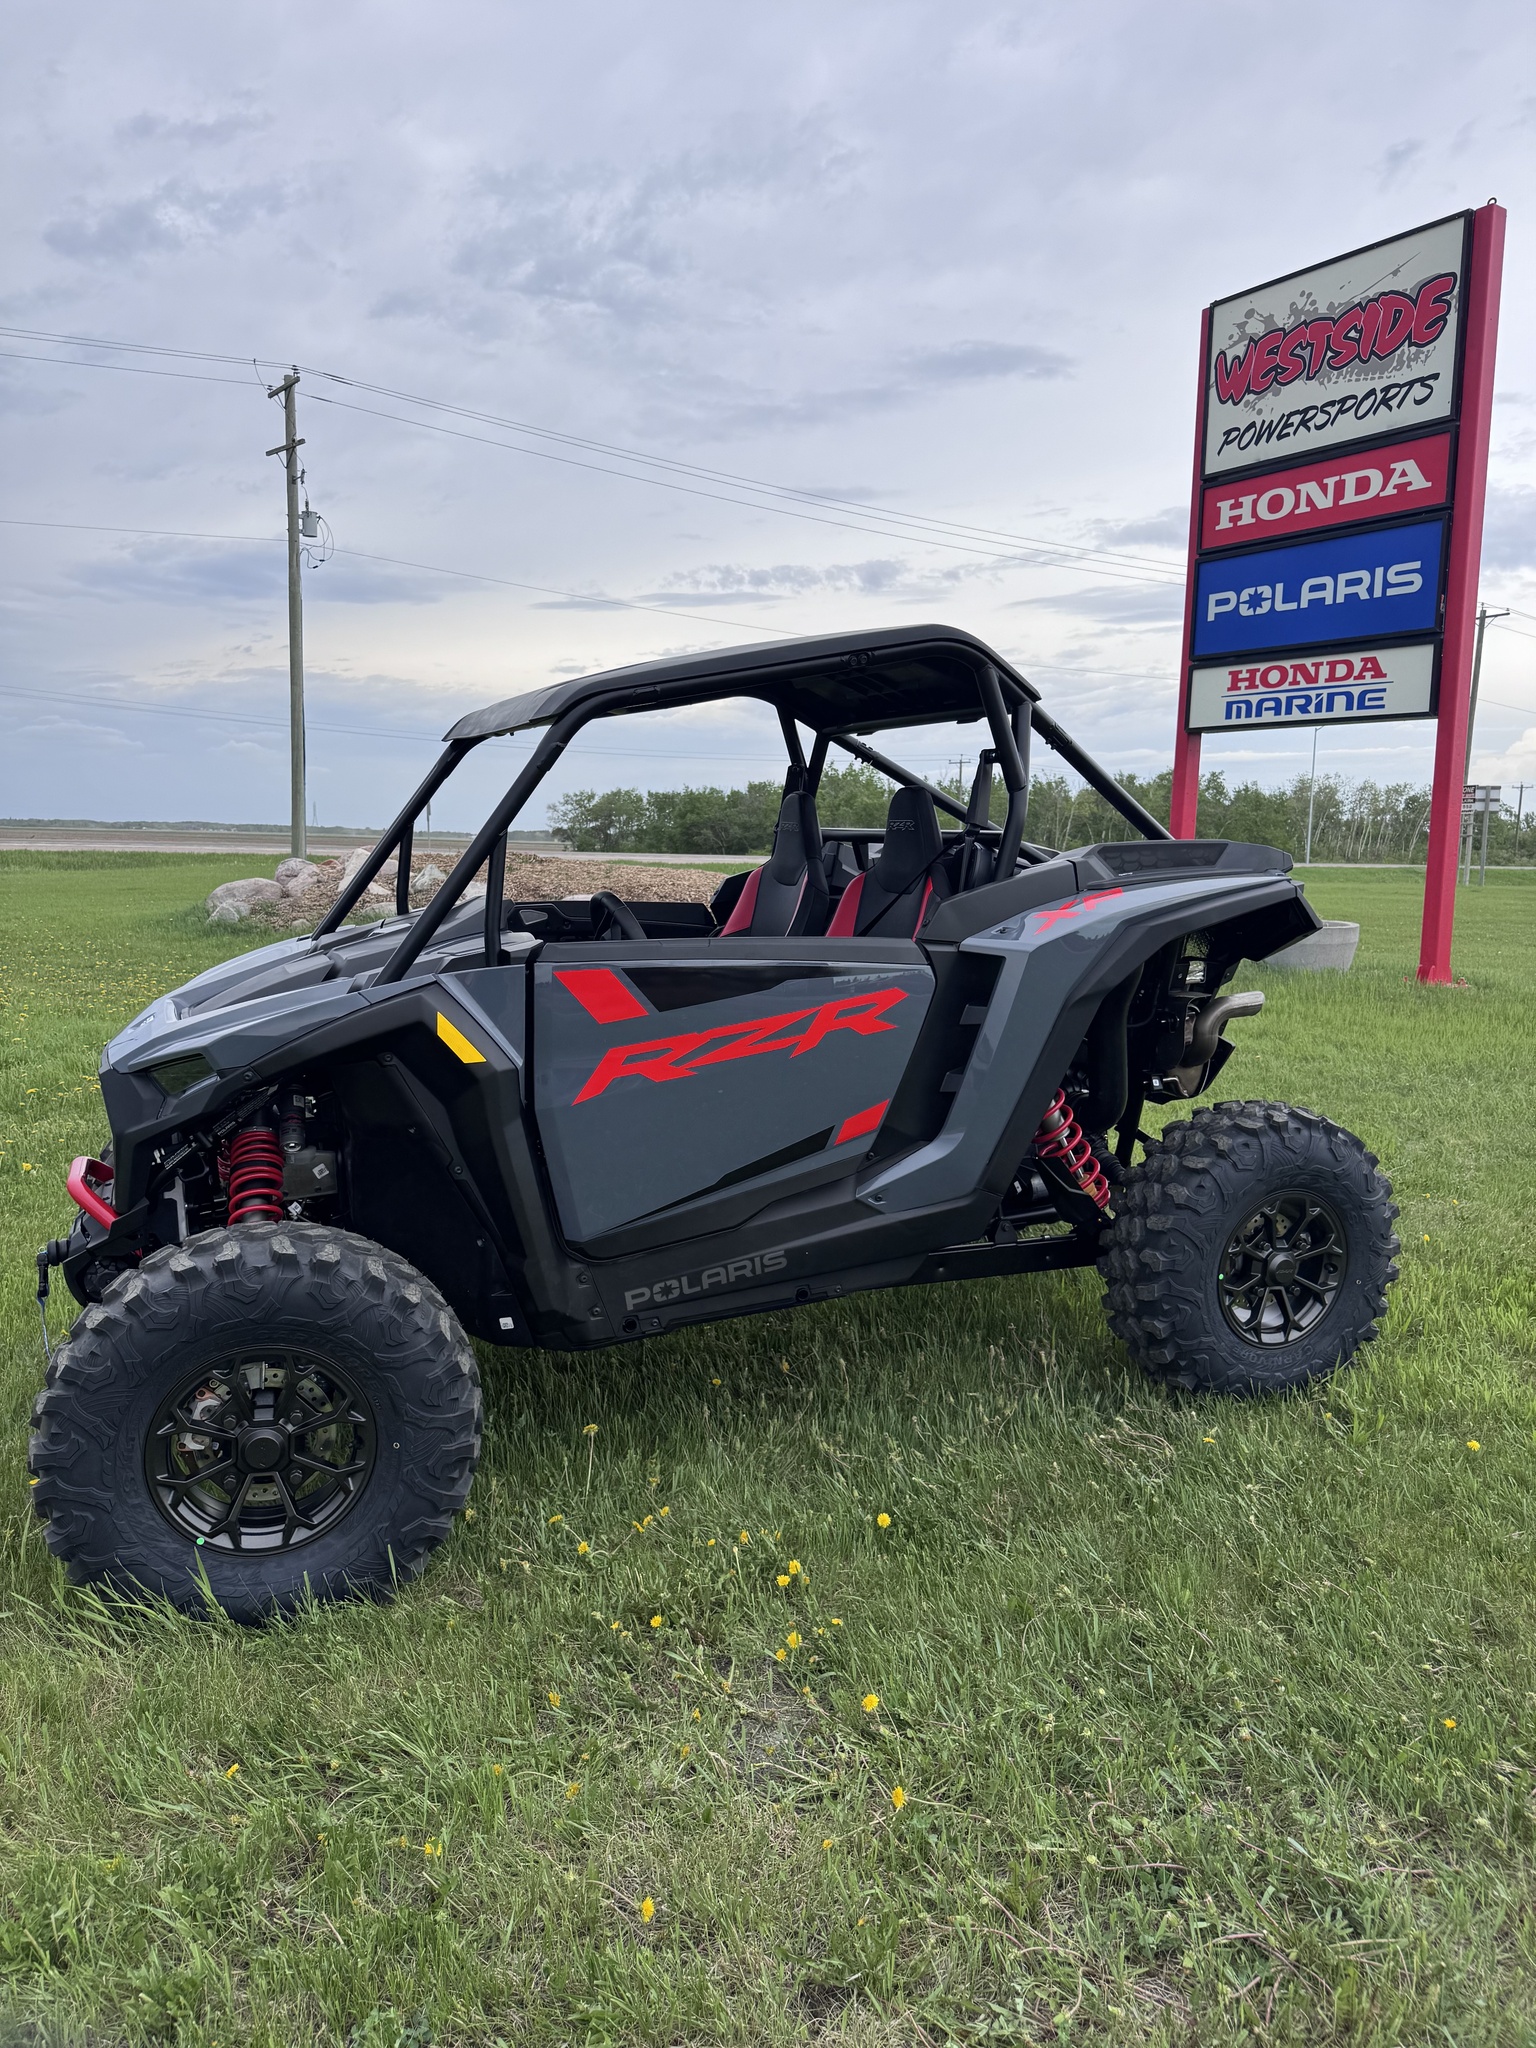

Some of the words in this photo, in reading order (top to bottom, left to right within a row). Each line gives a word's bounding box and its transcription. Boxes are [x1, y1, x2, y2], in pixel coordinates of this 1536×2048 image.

[1215, 272, 1457, 405] WESTSIDE
[1218, 373, 1440, 456] POWERSPORTS
[1215, 459, 1431, 530] HONDA
[1207, 561, 1423, 621] POLARIS
[1224, 687, 1387, 721] MARINE
[1227, 656, 1387, 692] HONDA
[887, 819, 915, 831] RZR
[571, 987, 909, 1106] RZR
[624, 1250, 788, 1311] POLARIS
